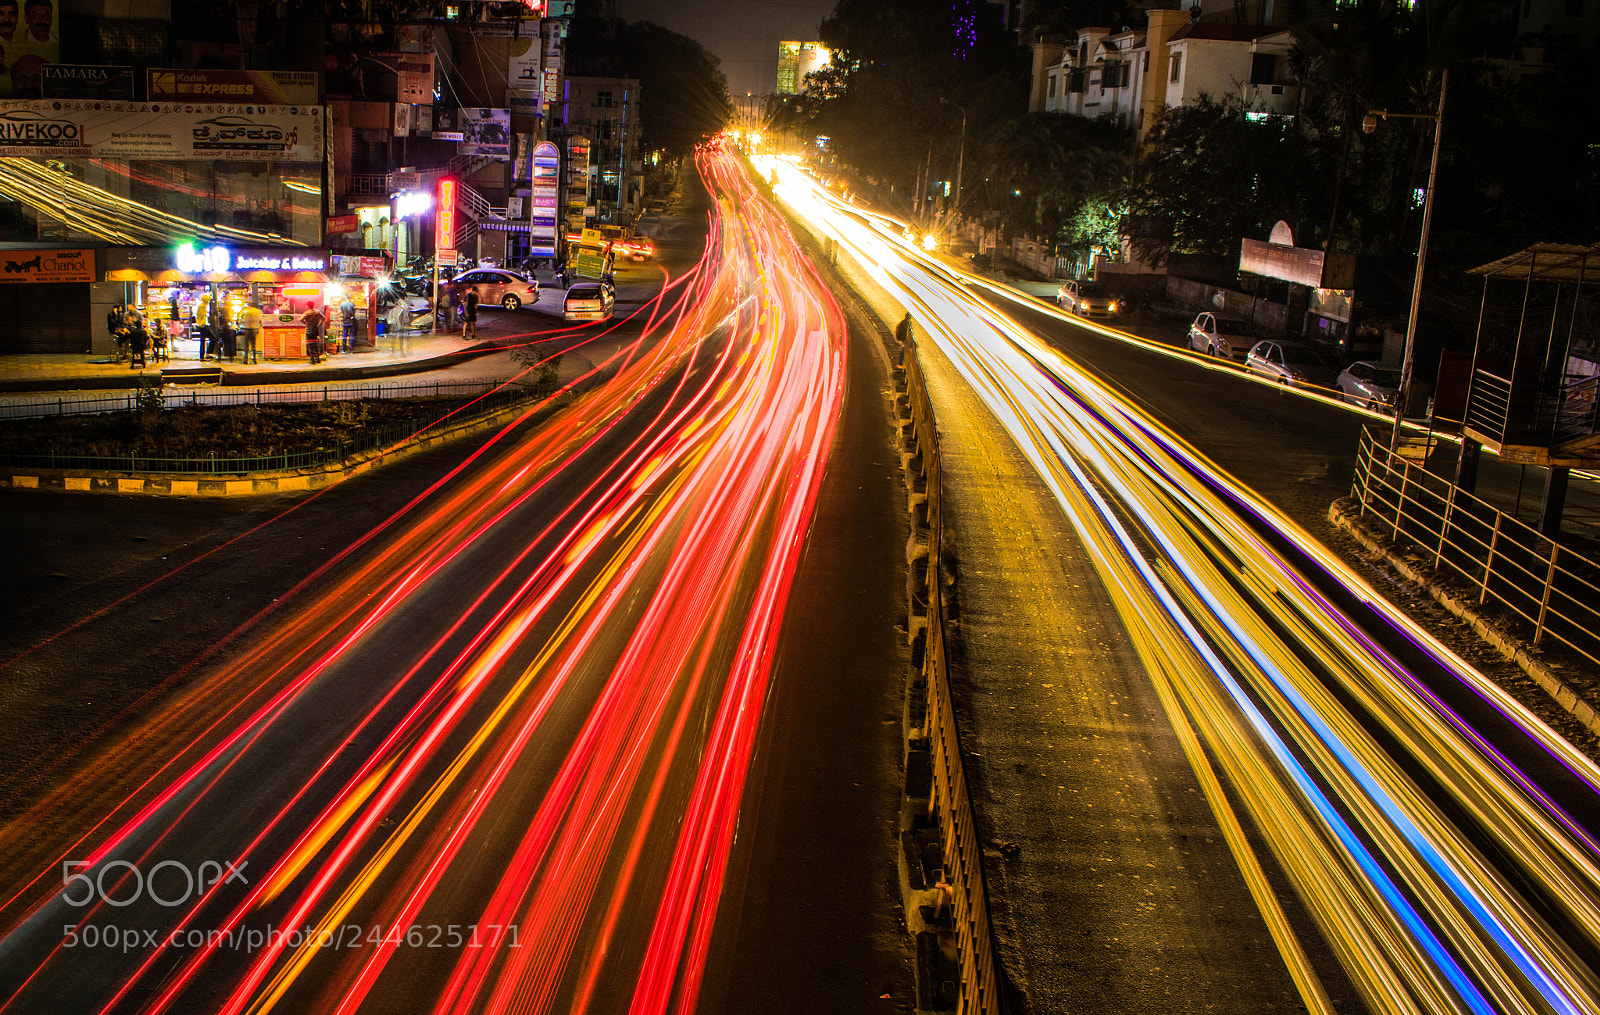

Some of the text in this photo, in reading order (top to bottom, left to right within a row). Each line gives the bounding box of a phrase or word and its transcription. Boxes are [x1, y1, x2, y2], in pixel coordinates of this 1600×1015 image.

[42, 67, 109, 79] TAMARA
[177, 73, 207, 83] Kodak
[193, 83, 255, 95] EXPRESS
[54, 139, 79, 147] .com
[441, 181, 452, 246] MEAT WORLD
[43, 257, 87, 271] Chariot
[282, 257, 291, 269] &
